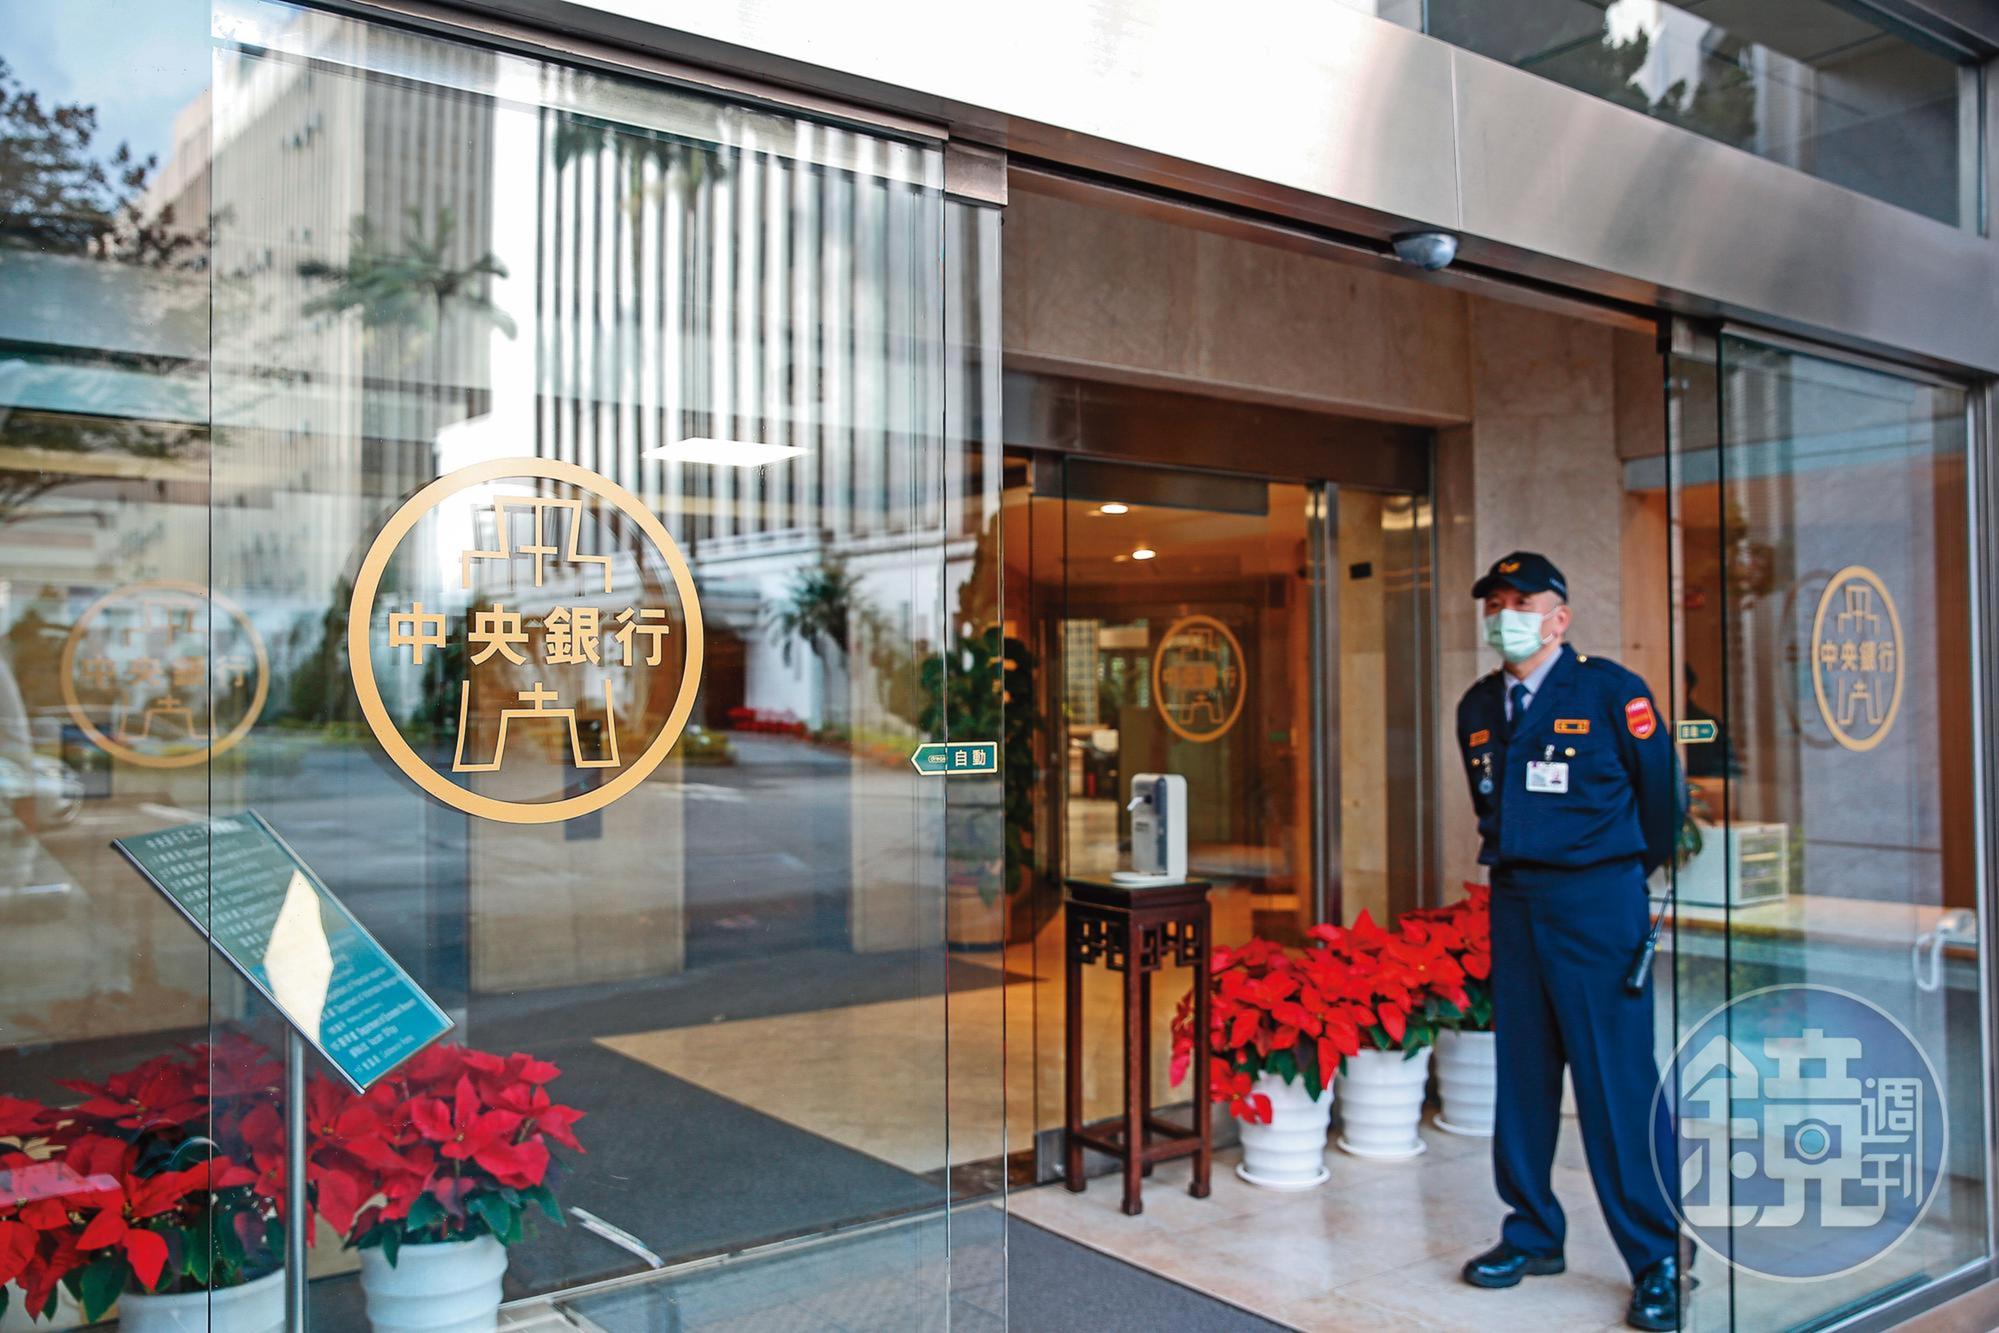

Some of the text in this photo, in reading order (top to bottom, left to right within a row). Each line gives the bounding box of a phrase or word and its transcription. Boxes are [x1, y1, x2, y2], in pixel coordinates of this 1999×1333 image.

[388, 601, 670, 667] 中央銀行
[955, 749, 987, 767] 自動
